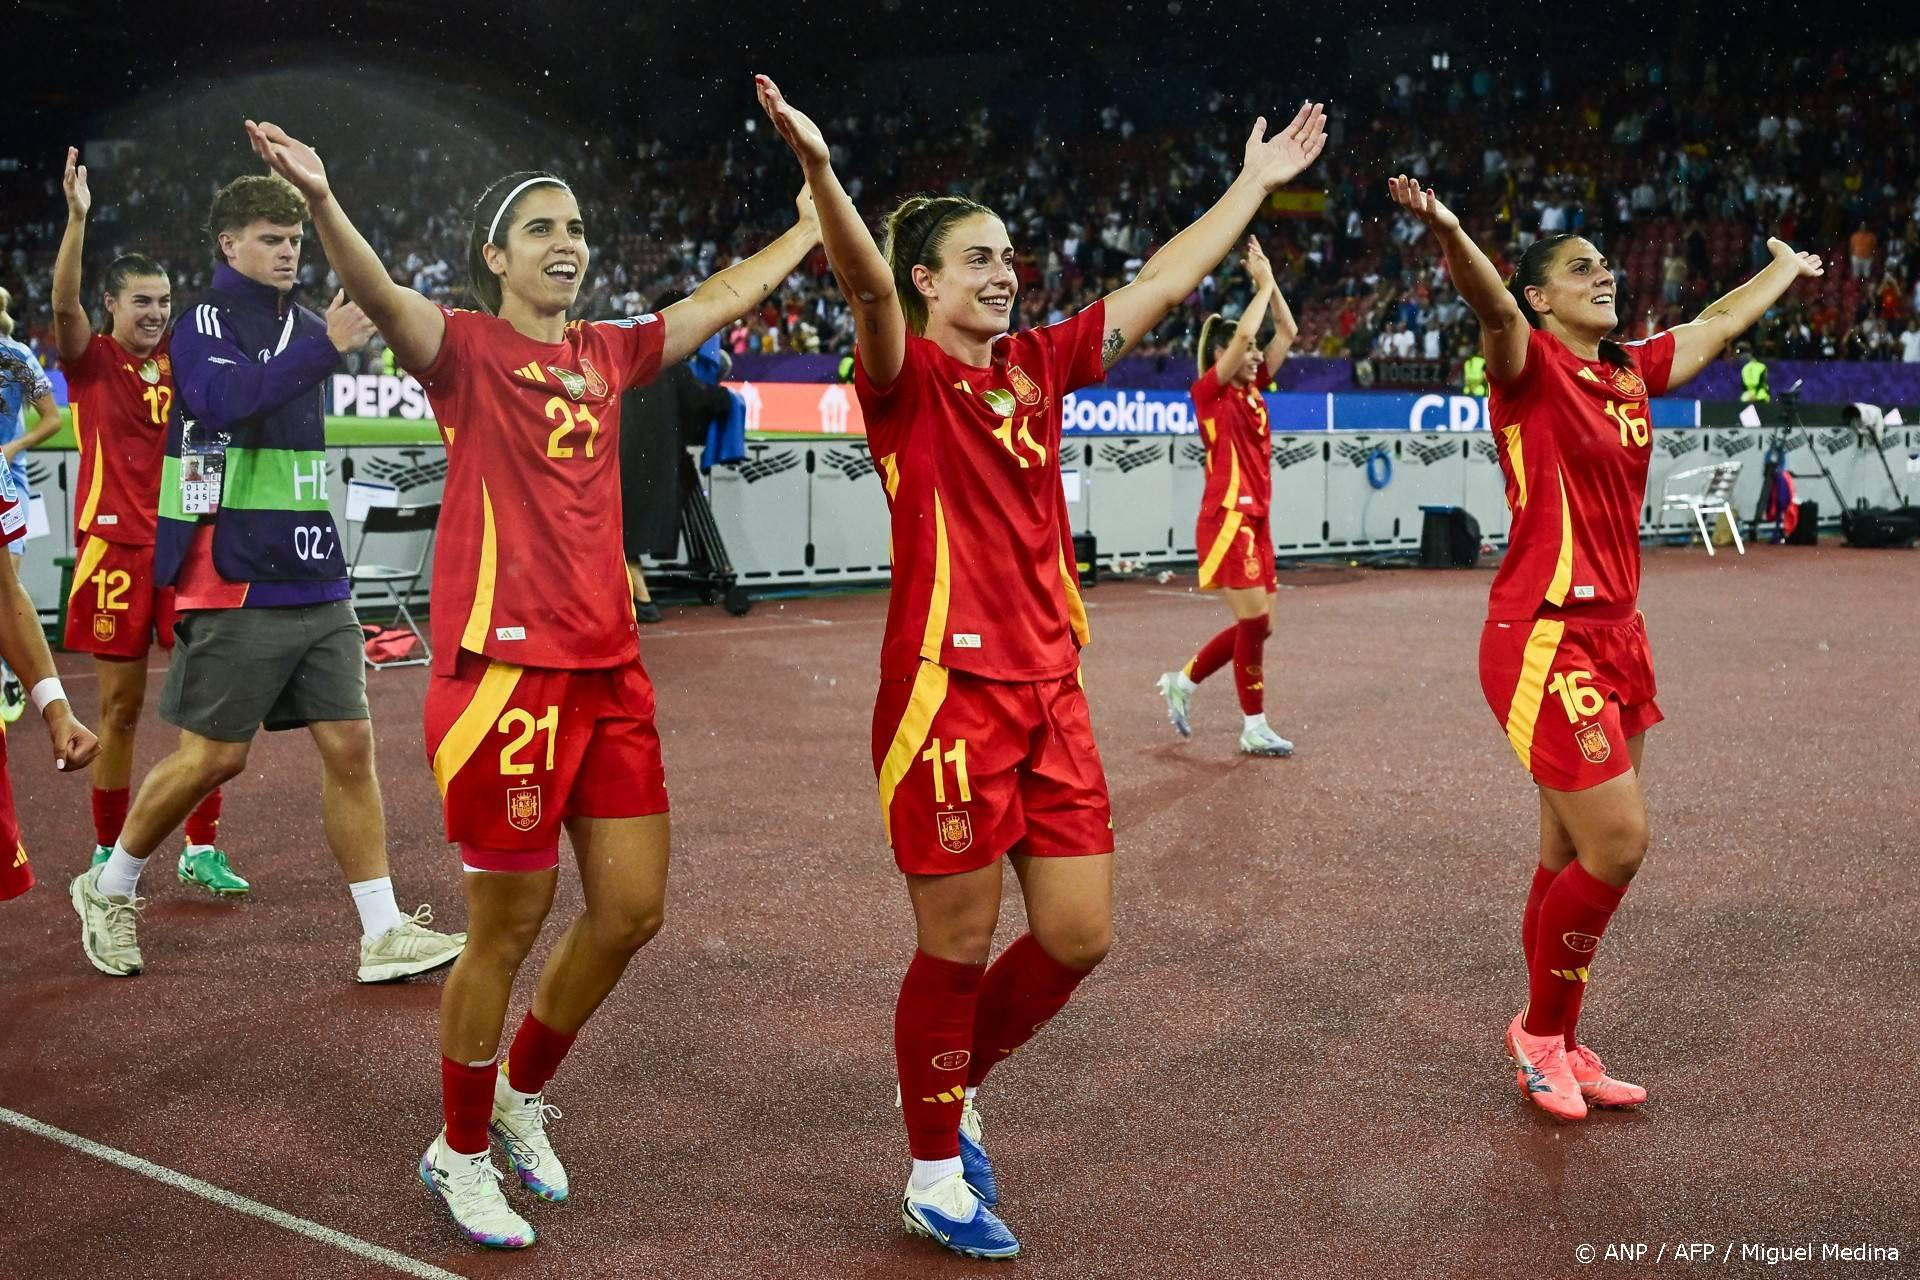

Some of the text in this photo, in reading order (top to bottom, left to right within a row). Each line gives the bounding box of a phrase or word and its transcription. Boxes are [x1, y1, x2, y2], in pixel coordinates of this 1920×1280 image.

[545, 396, 599, 458] 21
[1062, 391, 1198, 434] Booking.
[1604, 400, 1649, 447] 16
[992, 416, 1047, 468] 11
[1240, 526, 1255, 556] 7
[92, 570, 131, 610] 12
[1547, 671, 1605, 724] 16
[498, 706, 559, 775] 21
[922, 738, 972, 802] 11
